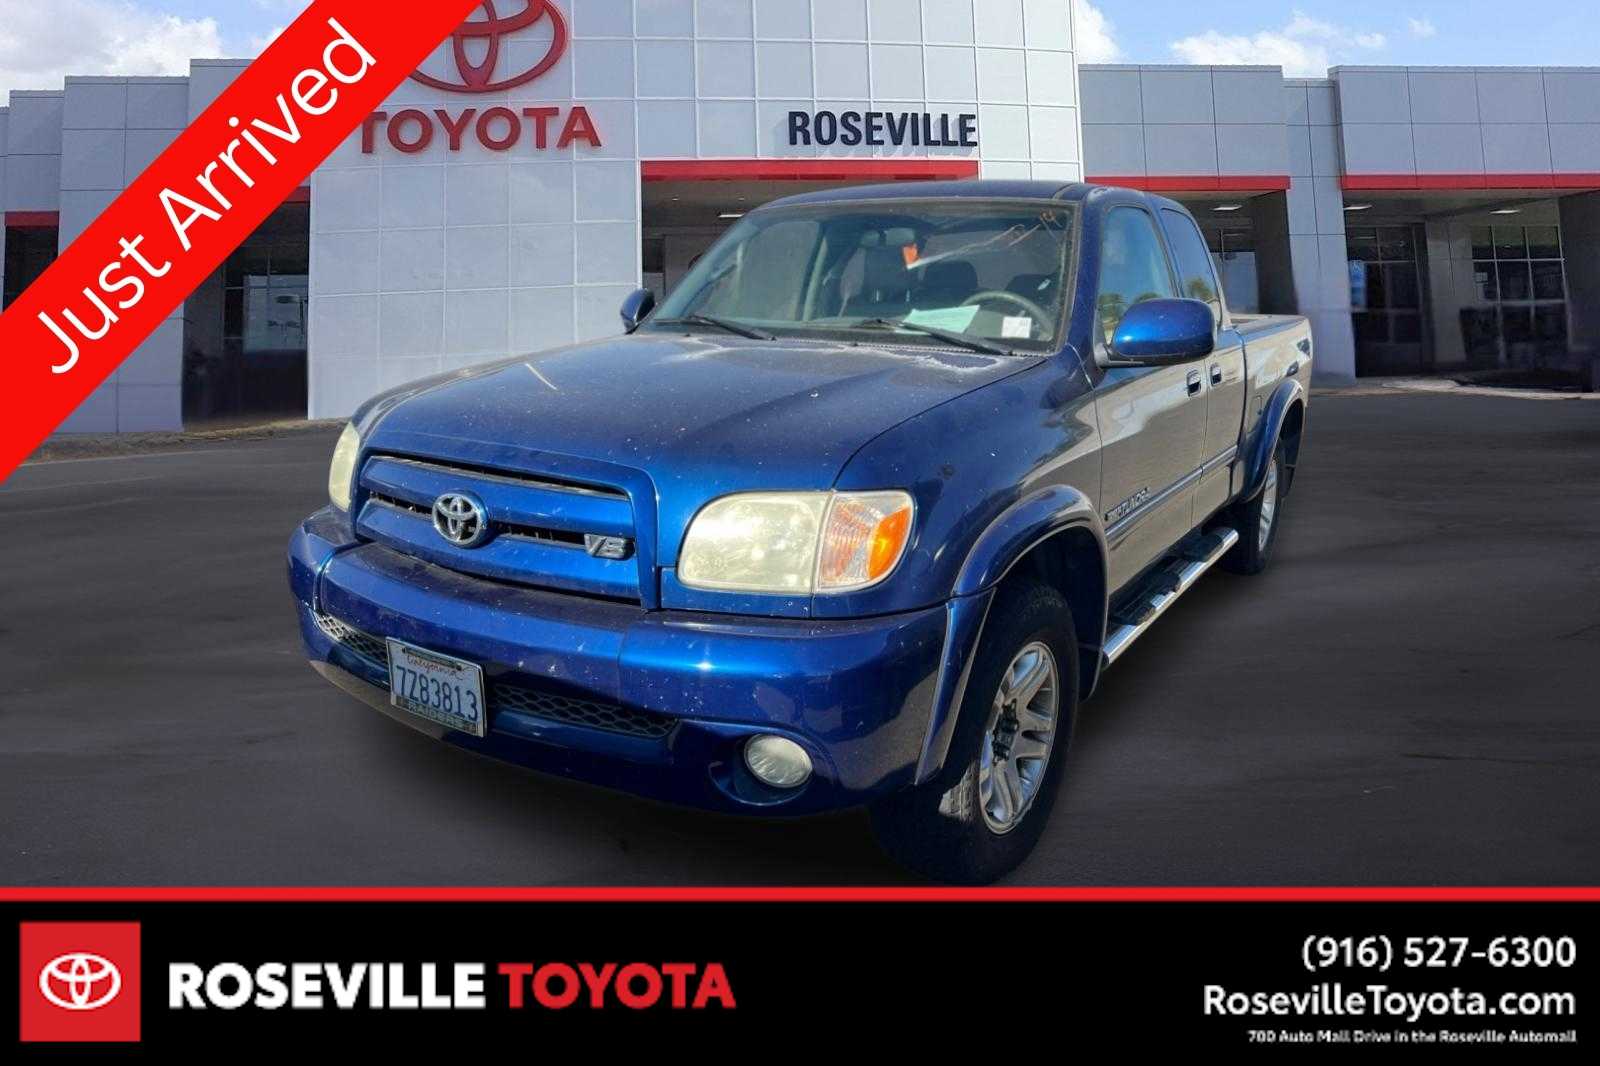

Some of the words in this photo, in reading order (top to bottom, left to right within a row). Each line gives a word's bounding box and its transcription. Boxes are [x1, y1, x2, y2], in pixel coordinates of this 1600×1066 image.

[362, 106, 599, 153] TOYOTA
[789, 111, 977, 146] ROSEVILLE
[584, 533, 626, 559] V8
[396, 665, 478, 722] 7Z83813
